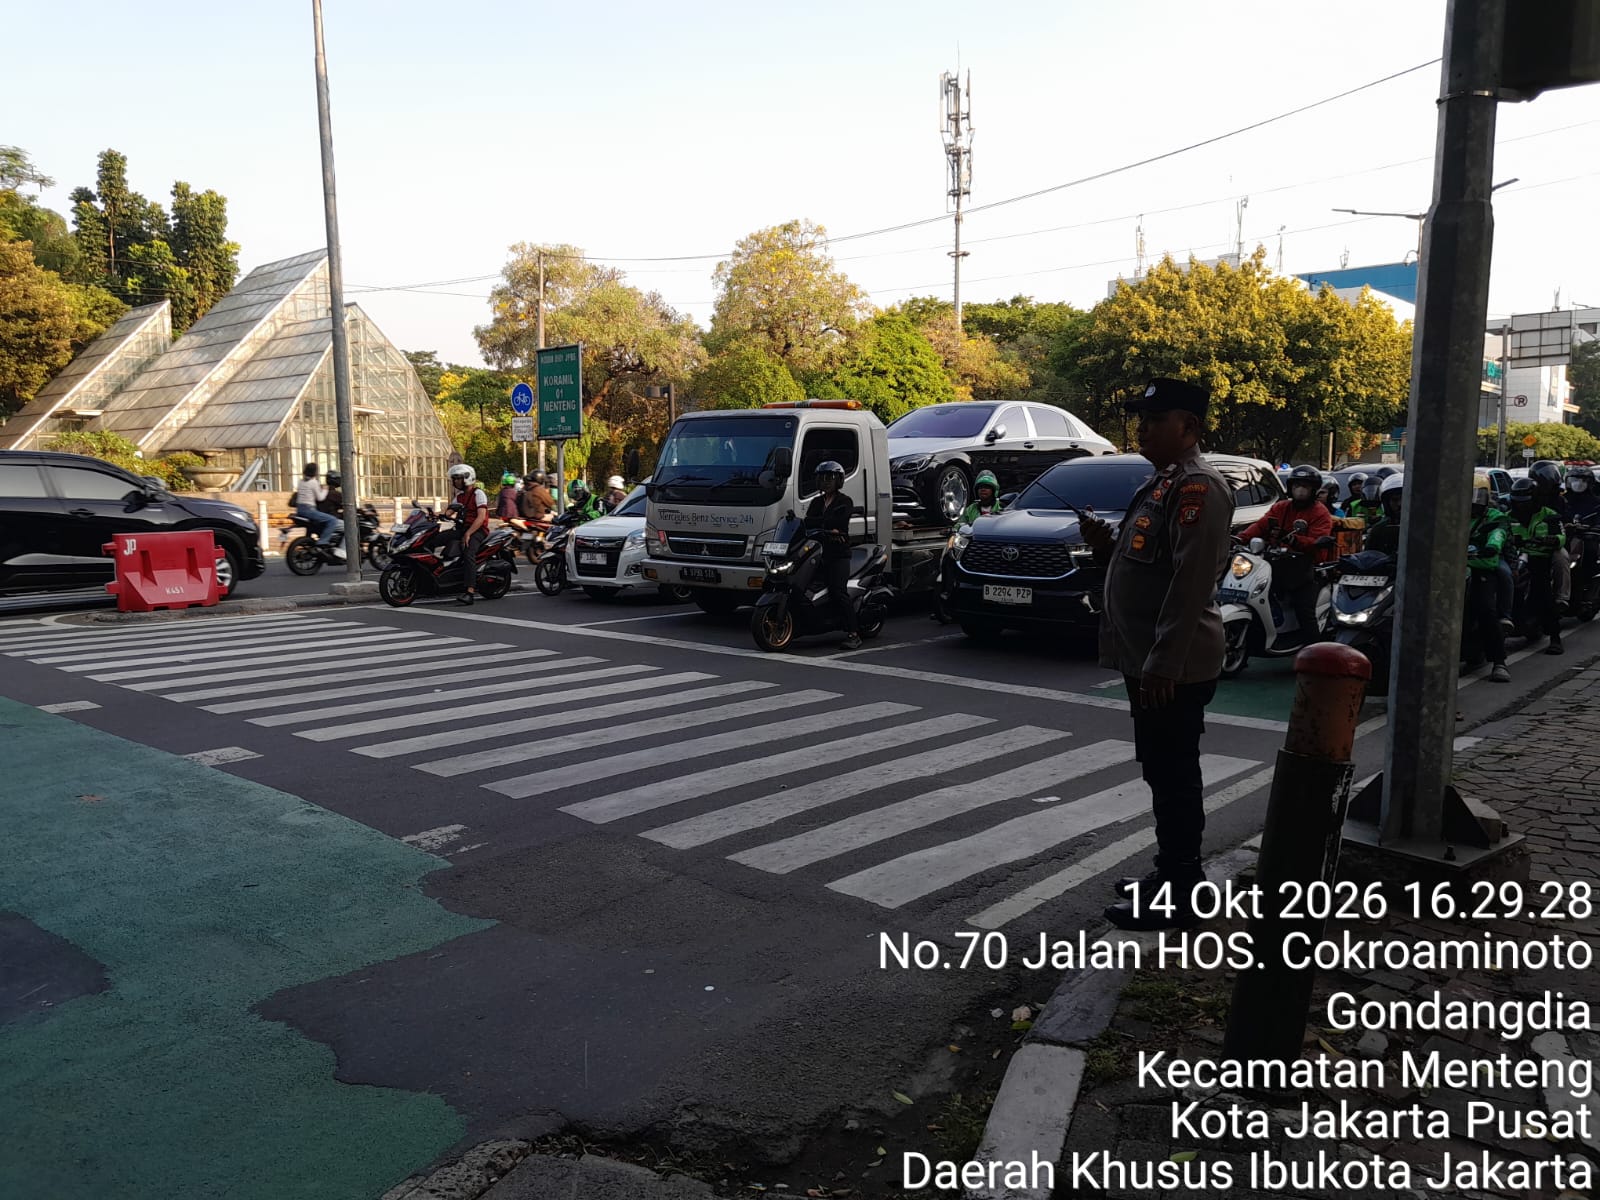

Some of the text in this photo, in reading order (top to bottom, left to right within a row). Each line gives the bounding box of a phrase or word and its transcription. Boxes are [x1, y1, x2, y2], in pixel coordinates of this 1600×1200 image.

[543, 374, 574, 387] KORAMIL
[555, 388, 564, 399] 01
[543, 400, 576, 412] MENTENG
[711, 513, 737, 525] Service
[739, 513, 754, 525] 24h
[123, 538, 137, 556] JP
[985, 585, 990, 596] B
[1016, 588, 1032, 599] PZP
